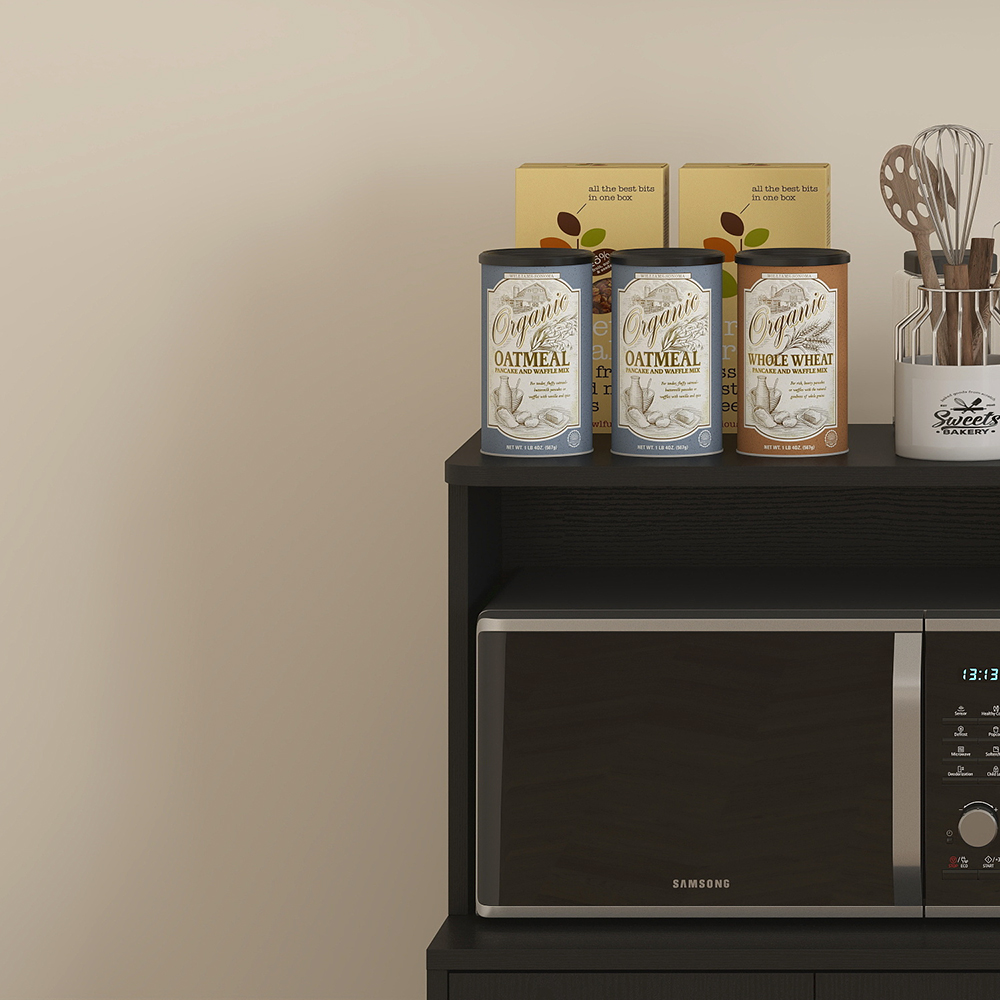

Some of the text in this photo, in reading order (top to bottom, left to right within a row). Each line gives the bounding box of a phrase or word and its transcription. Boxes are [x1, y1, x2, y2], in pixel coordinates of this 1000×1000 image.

[492, 292, 569, 349] Organic
[623, 292, 700, 349] Organic
[749, 292, 826, 349] Organic
[494, 350, 570, 367] OATMEAL
[625, 350, 701, 367] OATMEAL
[748, 353, 833, 366] WHOLE WHEAT
[962, 668, 999, 680] 13:13
